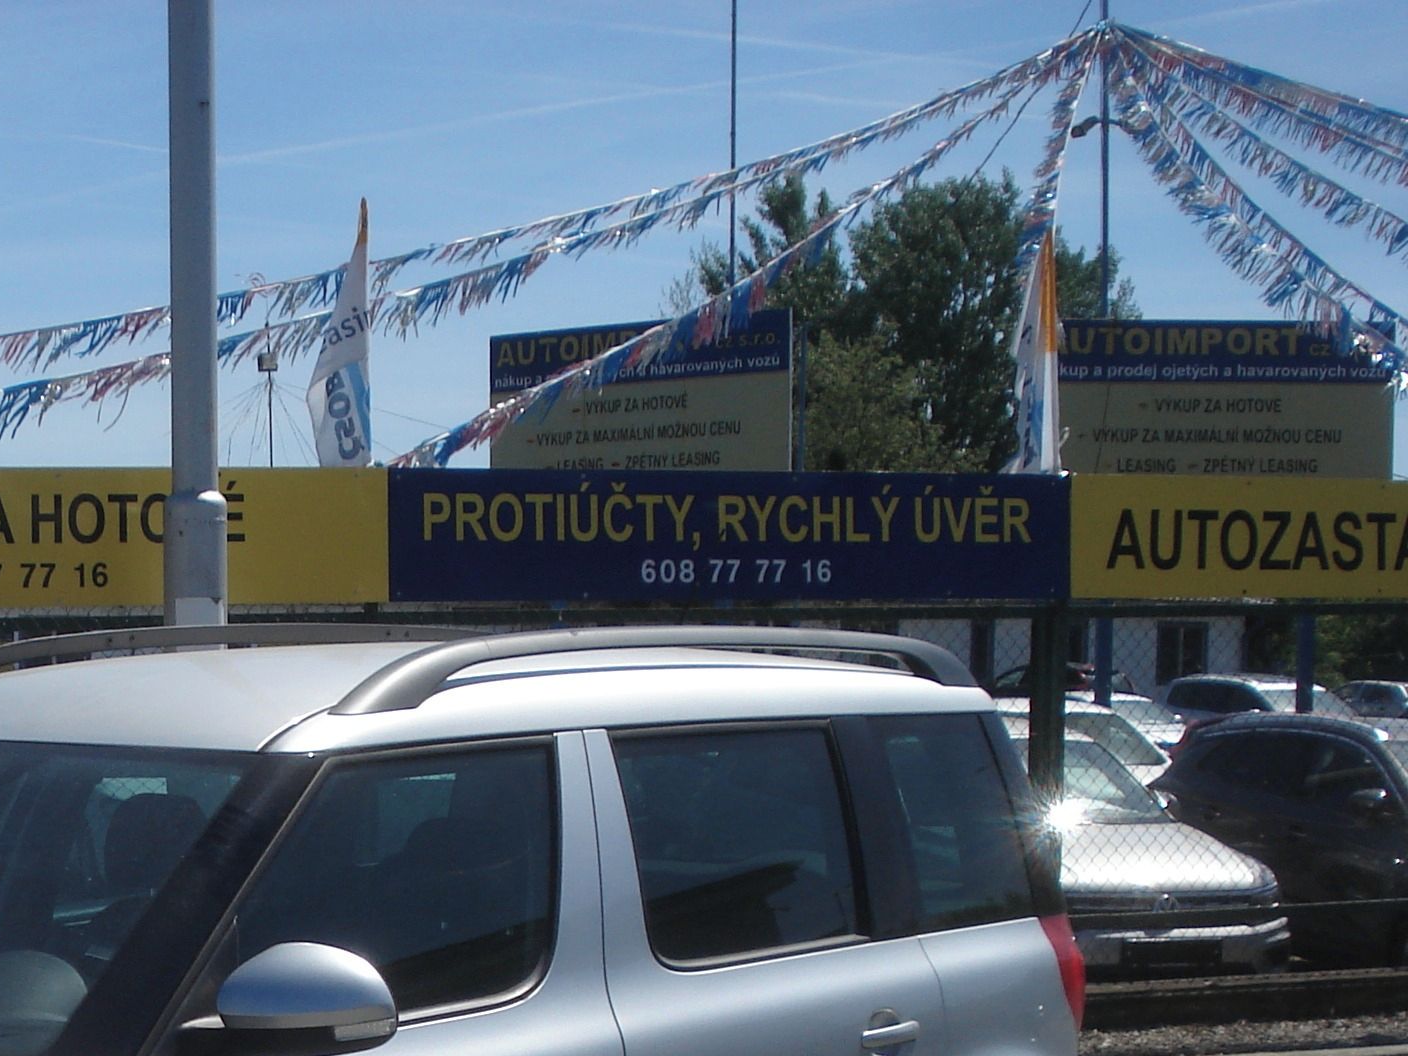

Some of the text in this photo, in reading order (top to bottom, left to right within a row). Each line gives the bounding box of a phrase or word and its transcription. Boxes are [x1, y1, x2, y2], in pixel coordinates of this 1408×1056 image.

[1309, 343, 1331, 357] cz
[495, 372, 532, 388] nákup
[650, 357, 743, 377] havarovaných
[1059, 363, 1089, 379] kup
[1094, 365, 1103, 377] a
[1108, 363, 1157, 380] prodej
[1162, 363, 1218, 380] ojetých
[1224, 365, 1233, 377] a
[1237, 364, 1346, 380] havarovaných
[624, 399, 640, 412] ZA
[642, 392, 688, 411] HOTOVÉ
[1204, 399, 1223, 413] ZA
[576, 432, 590, 444] ZA
[657, 422, 706, 439] MOŽNOU
[710, 421, 741, 436] CENU
[1142, 428, 1160, 443] ZA
[1243, 426, 1301, 443] MOŽNOU
[1305, 428, 1342, 443] CENU
[672, 451, 721, 468] LEASING
[1117, 458, 1176, 473] LEASING
[1259, 458, 1319, 473] LEASING
[31, 480, 246, 544] HOTOÉ
[423, 482, 1032, 551] PROTIÚČTY, RYCHLÝ ÚVĚR
[20, 562, 57, 589] 77
[73, 562, 109, 588] 16
[641, 559, 832, 583] 608 77 77 16
